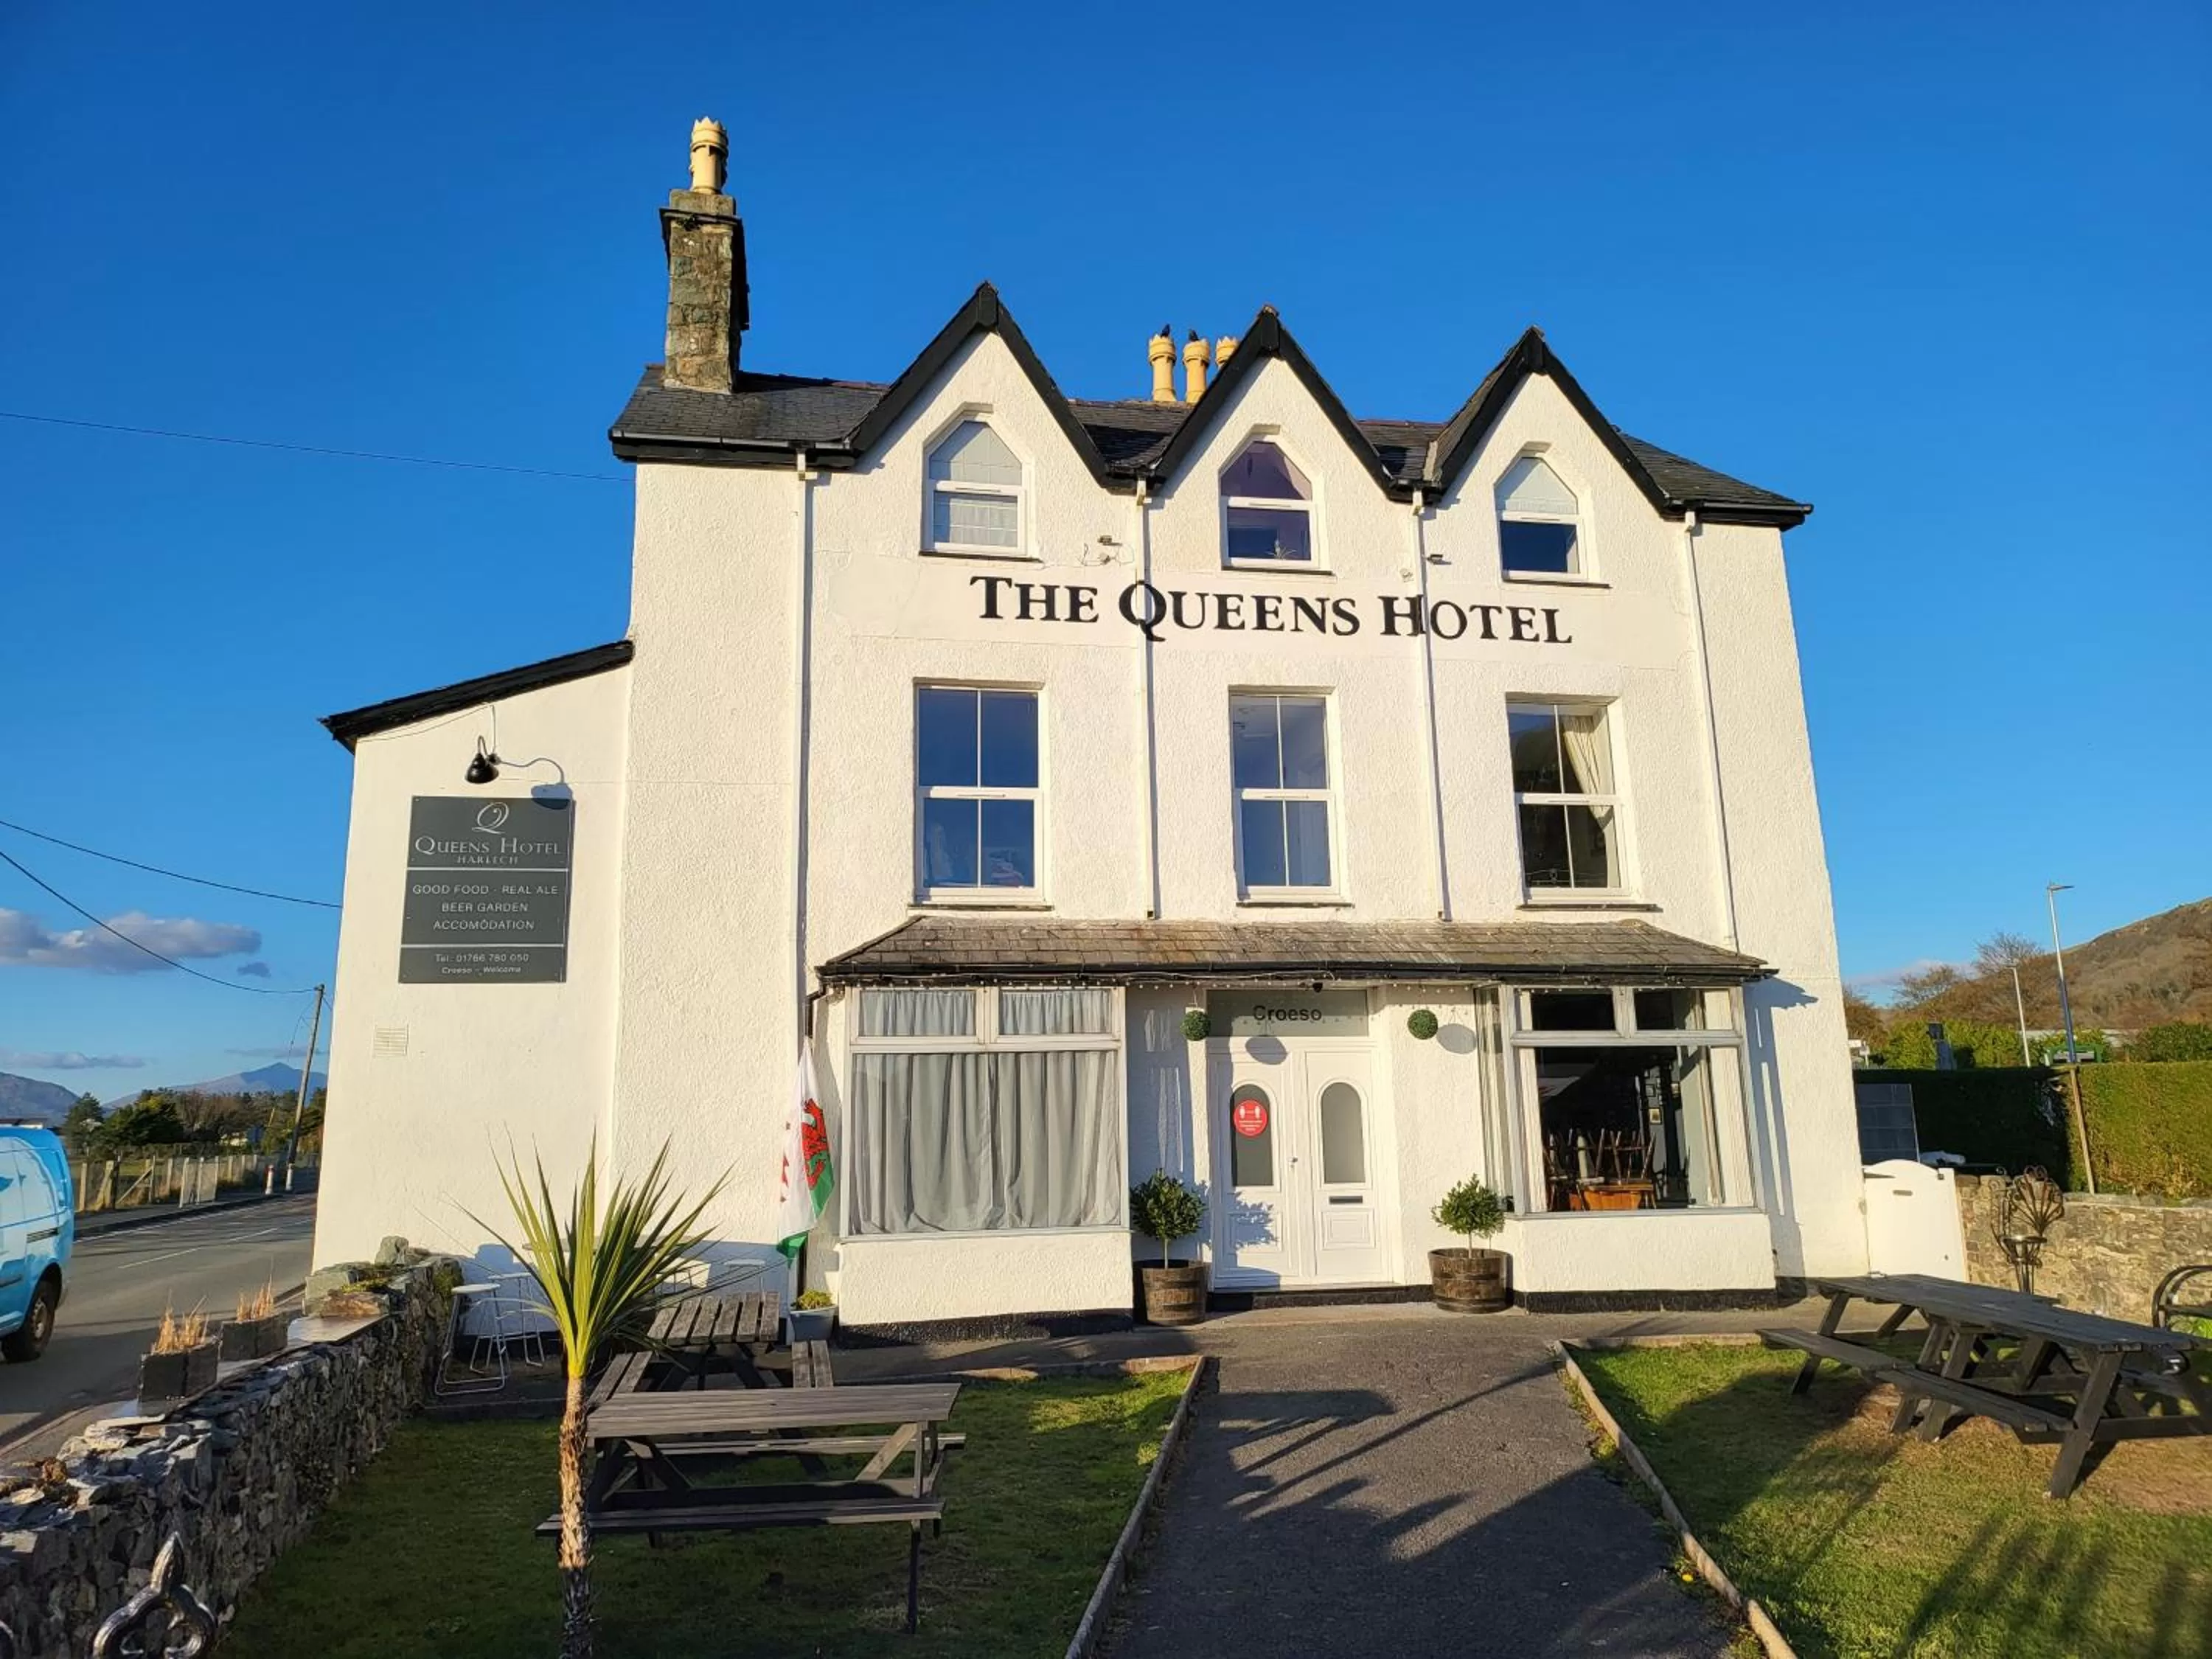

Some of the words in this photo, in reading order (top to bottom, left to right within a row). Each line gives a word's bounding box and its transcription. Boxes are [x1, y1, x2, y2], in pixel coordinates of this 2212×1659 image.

[969, 575, 1099, 624] THE
[1118, 580, 1360, 643] QUEENS
[1377, 594, 1573, 644] HOTEL
[414, 835, 490, 855] QUEENS
[501, 837, 562, 855] HOTEL
[456, 855, 518, 865] HARLECH
[412, 884, 451, 894] GOOD
[453, 884, 490, 894] FOOD
[501, 885, 532, 894] REAL
[536, 886, 559, 894] ALE
[442, 902, 473, 912] BEER
[477, 902, 529, 912] GARDEN
[433, 919, 535, 931] ACCOMODATION
[1253, 1005, 1322, 1021] Croeso
